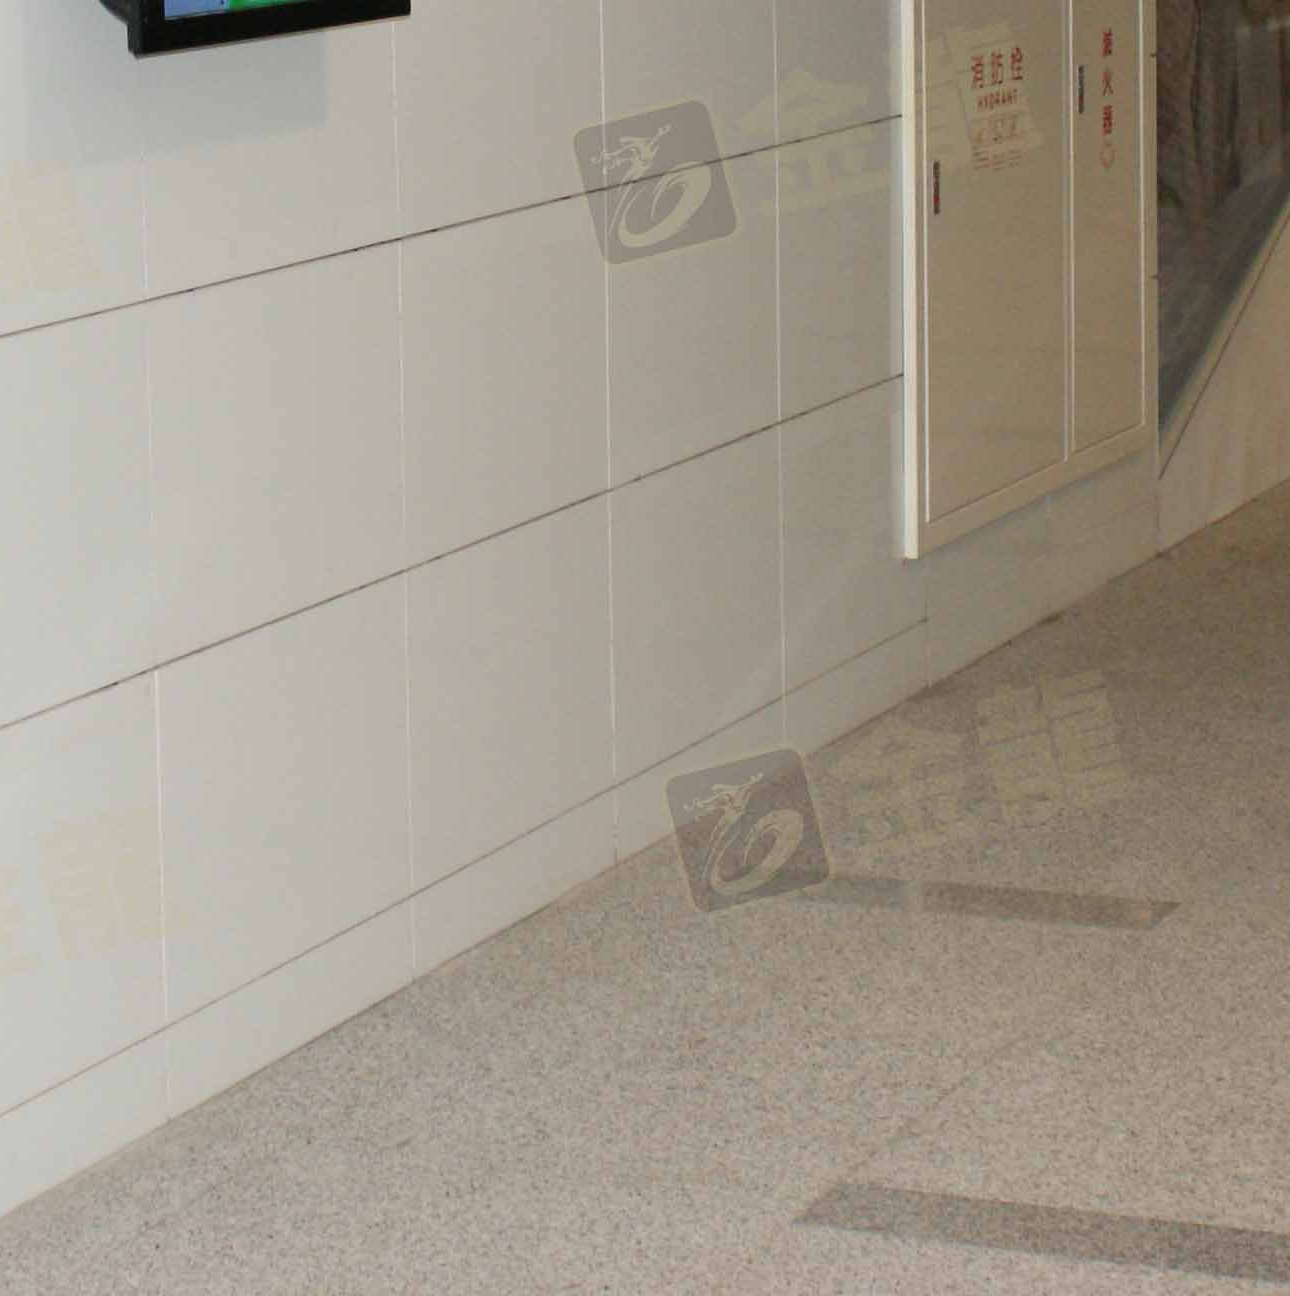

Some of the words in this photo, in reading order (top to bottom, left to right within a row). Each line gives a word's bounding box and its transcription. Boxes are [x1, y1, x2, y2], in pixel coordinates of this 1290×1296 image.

[970, 46, 1024, 88] 消防栓
[976, 89, 1019, 112] HYDRANT
